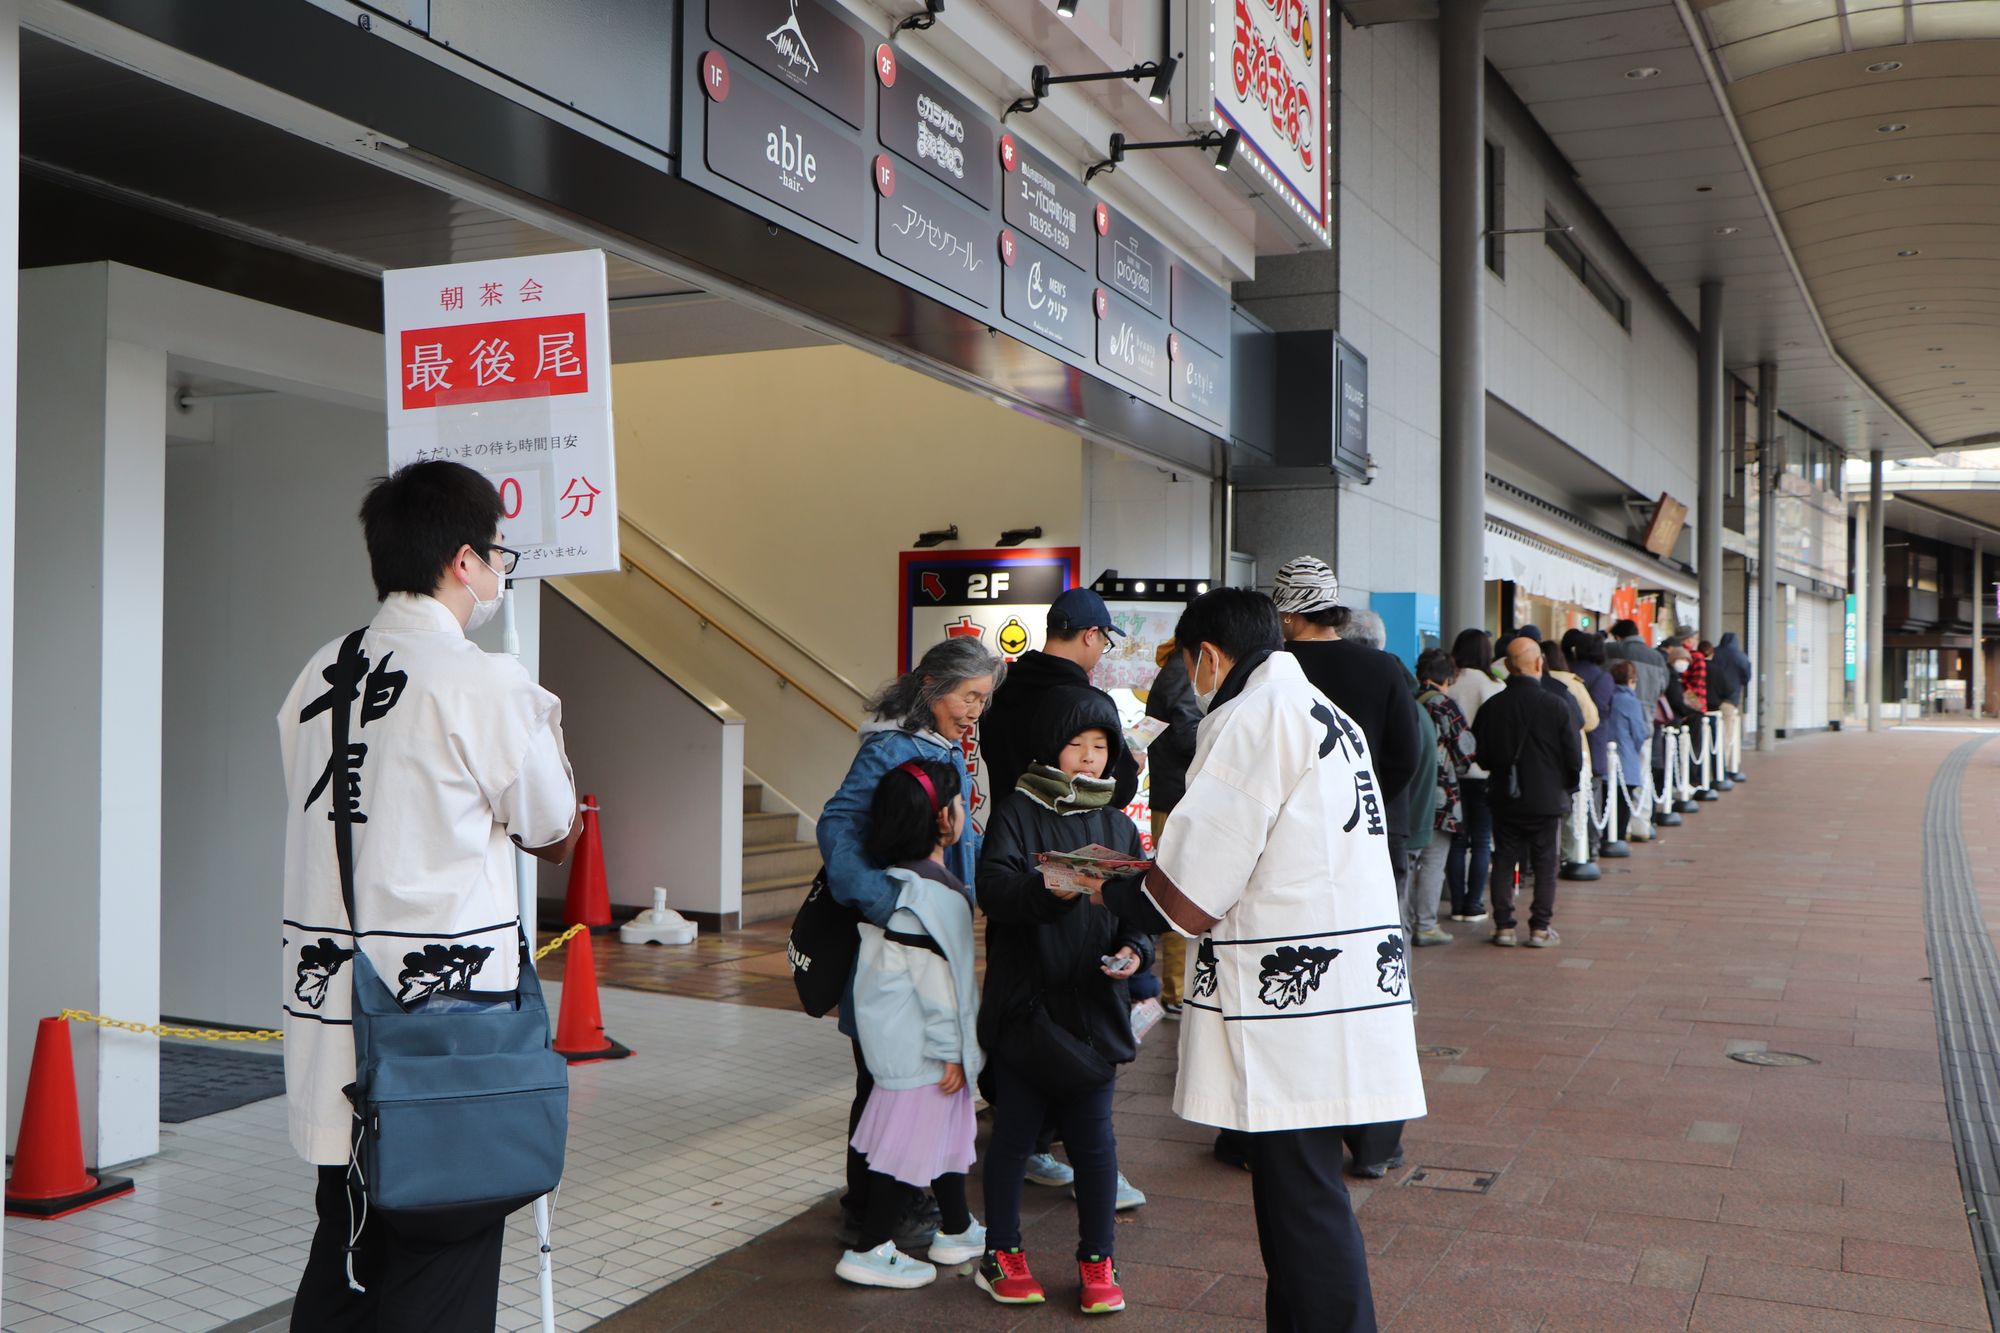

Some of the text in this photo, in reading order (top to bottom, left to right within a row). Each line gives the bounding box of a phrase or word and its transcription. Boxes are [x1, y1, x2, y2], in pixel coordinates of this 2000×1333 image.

[711, 65, 723, 87] 1F
[881, 56, 892, 73] 2F
[766, 125, 817, 183] able
[917, 120, 965, 178] まねきねこ
[778, 175, 804, 192] -hair-
[881, 166, 891, 185] 1F
[1117, 260, 1150, 294] progress
[440, 278, 544, 312] 朝茶会
[406, 330, 582, 393] 最後尾
[416, 434, 578, 462] ただいまの待ち時間目安
[966, 572, 1010, 599] 2F
